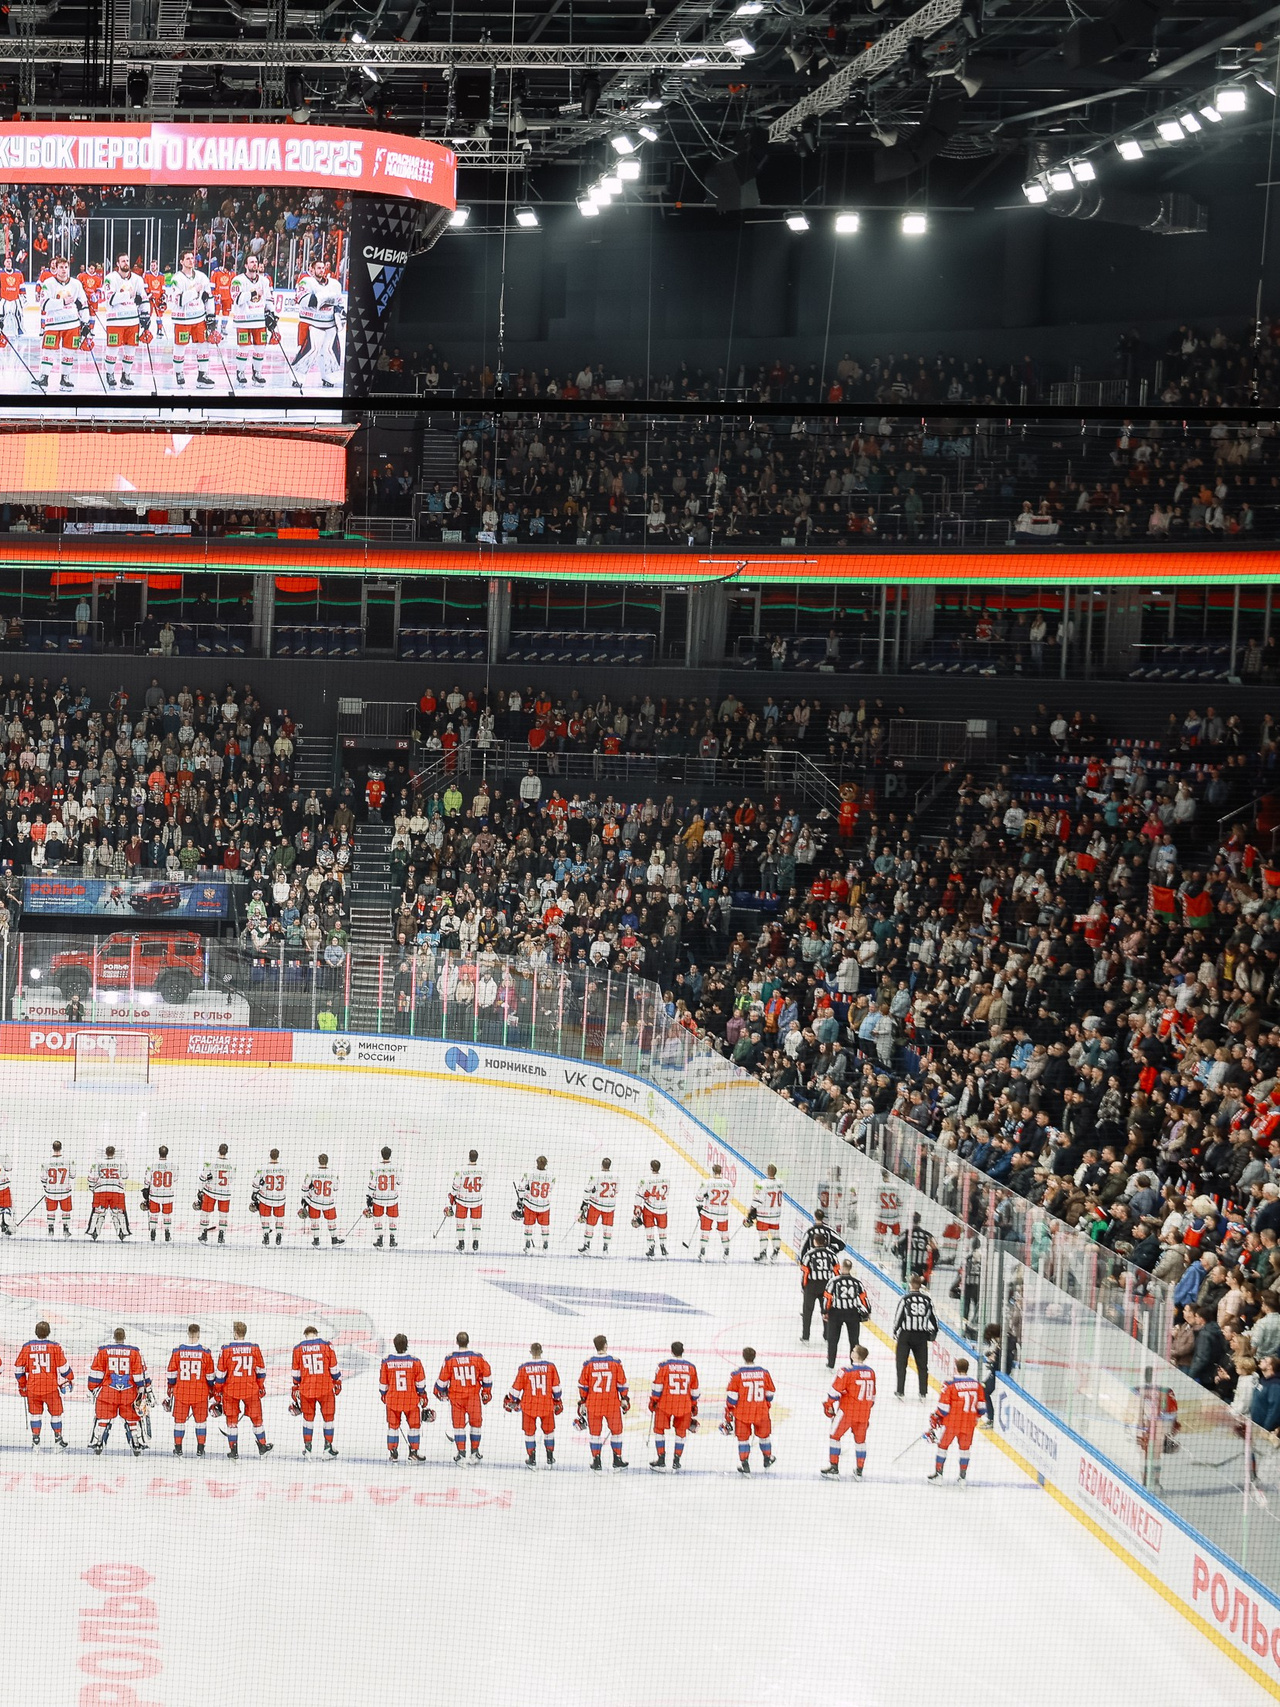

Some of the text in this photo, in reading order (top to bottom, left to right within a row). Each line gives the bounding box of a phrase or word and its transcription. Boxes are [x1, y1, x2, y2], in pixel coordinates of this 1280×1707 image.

[77, 135, 184, 170] ПЕРВОГО
[185, 136, 282, 171] КАНАЛА
[384, 164, 420, 182] МАШИНА
[362, 245, 409, 264] СИБИРЬ
[30, 883, 86, 896] РОЛЬФ
[28, 1006, 67, 1017] РОЛЬФ
[193, 1011, 233, 1020] РОЛЬФ
[29, 1031, 118, 1051] РОЛЬФ
[188, 1034, 231, 1045] КРАСНАЯ
[358, 1041, 408, 1053] МИНСПОРТ
[186, 1043, 230, 1055] МАШИНА
[358, 1052, 396, 1063] РОССИИ
[485, 1058, 548, 1077] НОРНИКЕЛЬ
[563, 1069, 641, 1104] VK СПОРТ
[47, 1167, 68, 1185] 97
[152, 1171, 173, 1188] 80
[218, 1169, 228, 1187] 5
[265, 1174, 286, 1192] 93
[377, 1174, 395, 1191] 81
[462, 1176, 483, 1193] 46
[312, 1179, 333, 1197] 96
[530, 1181, 551, 1198] 68
[709, 1188, 730, 1206] 22
[816, 1257, 829, 1270] 31
[840, 1286, 856, 1299] 24
[29, 1353, 51, 1374] 34
[179, 1359, 202, 1381] 89
[231, 1355, 253, 1377] 24
[302, 1353, 324, 1375] 96
[395, 1370, 407, 1392] 6
[453, 1365, 476, 1387] 44
[528, 1374, 547, 1396] 14
[591, 1371, 613, 1394] 27
[669, 1373, 690, 1395] 53
[742, 1380, 765, 1402] 76
[855, 1379, 875, 1401] 70
